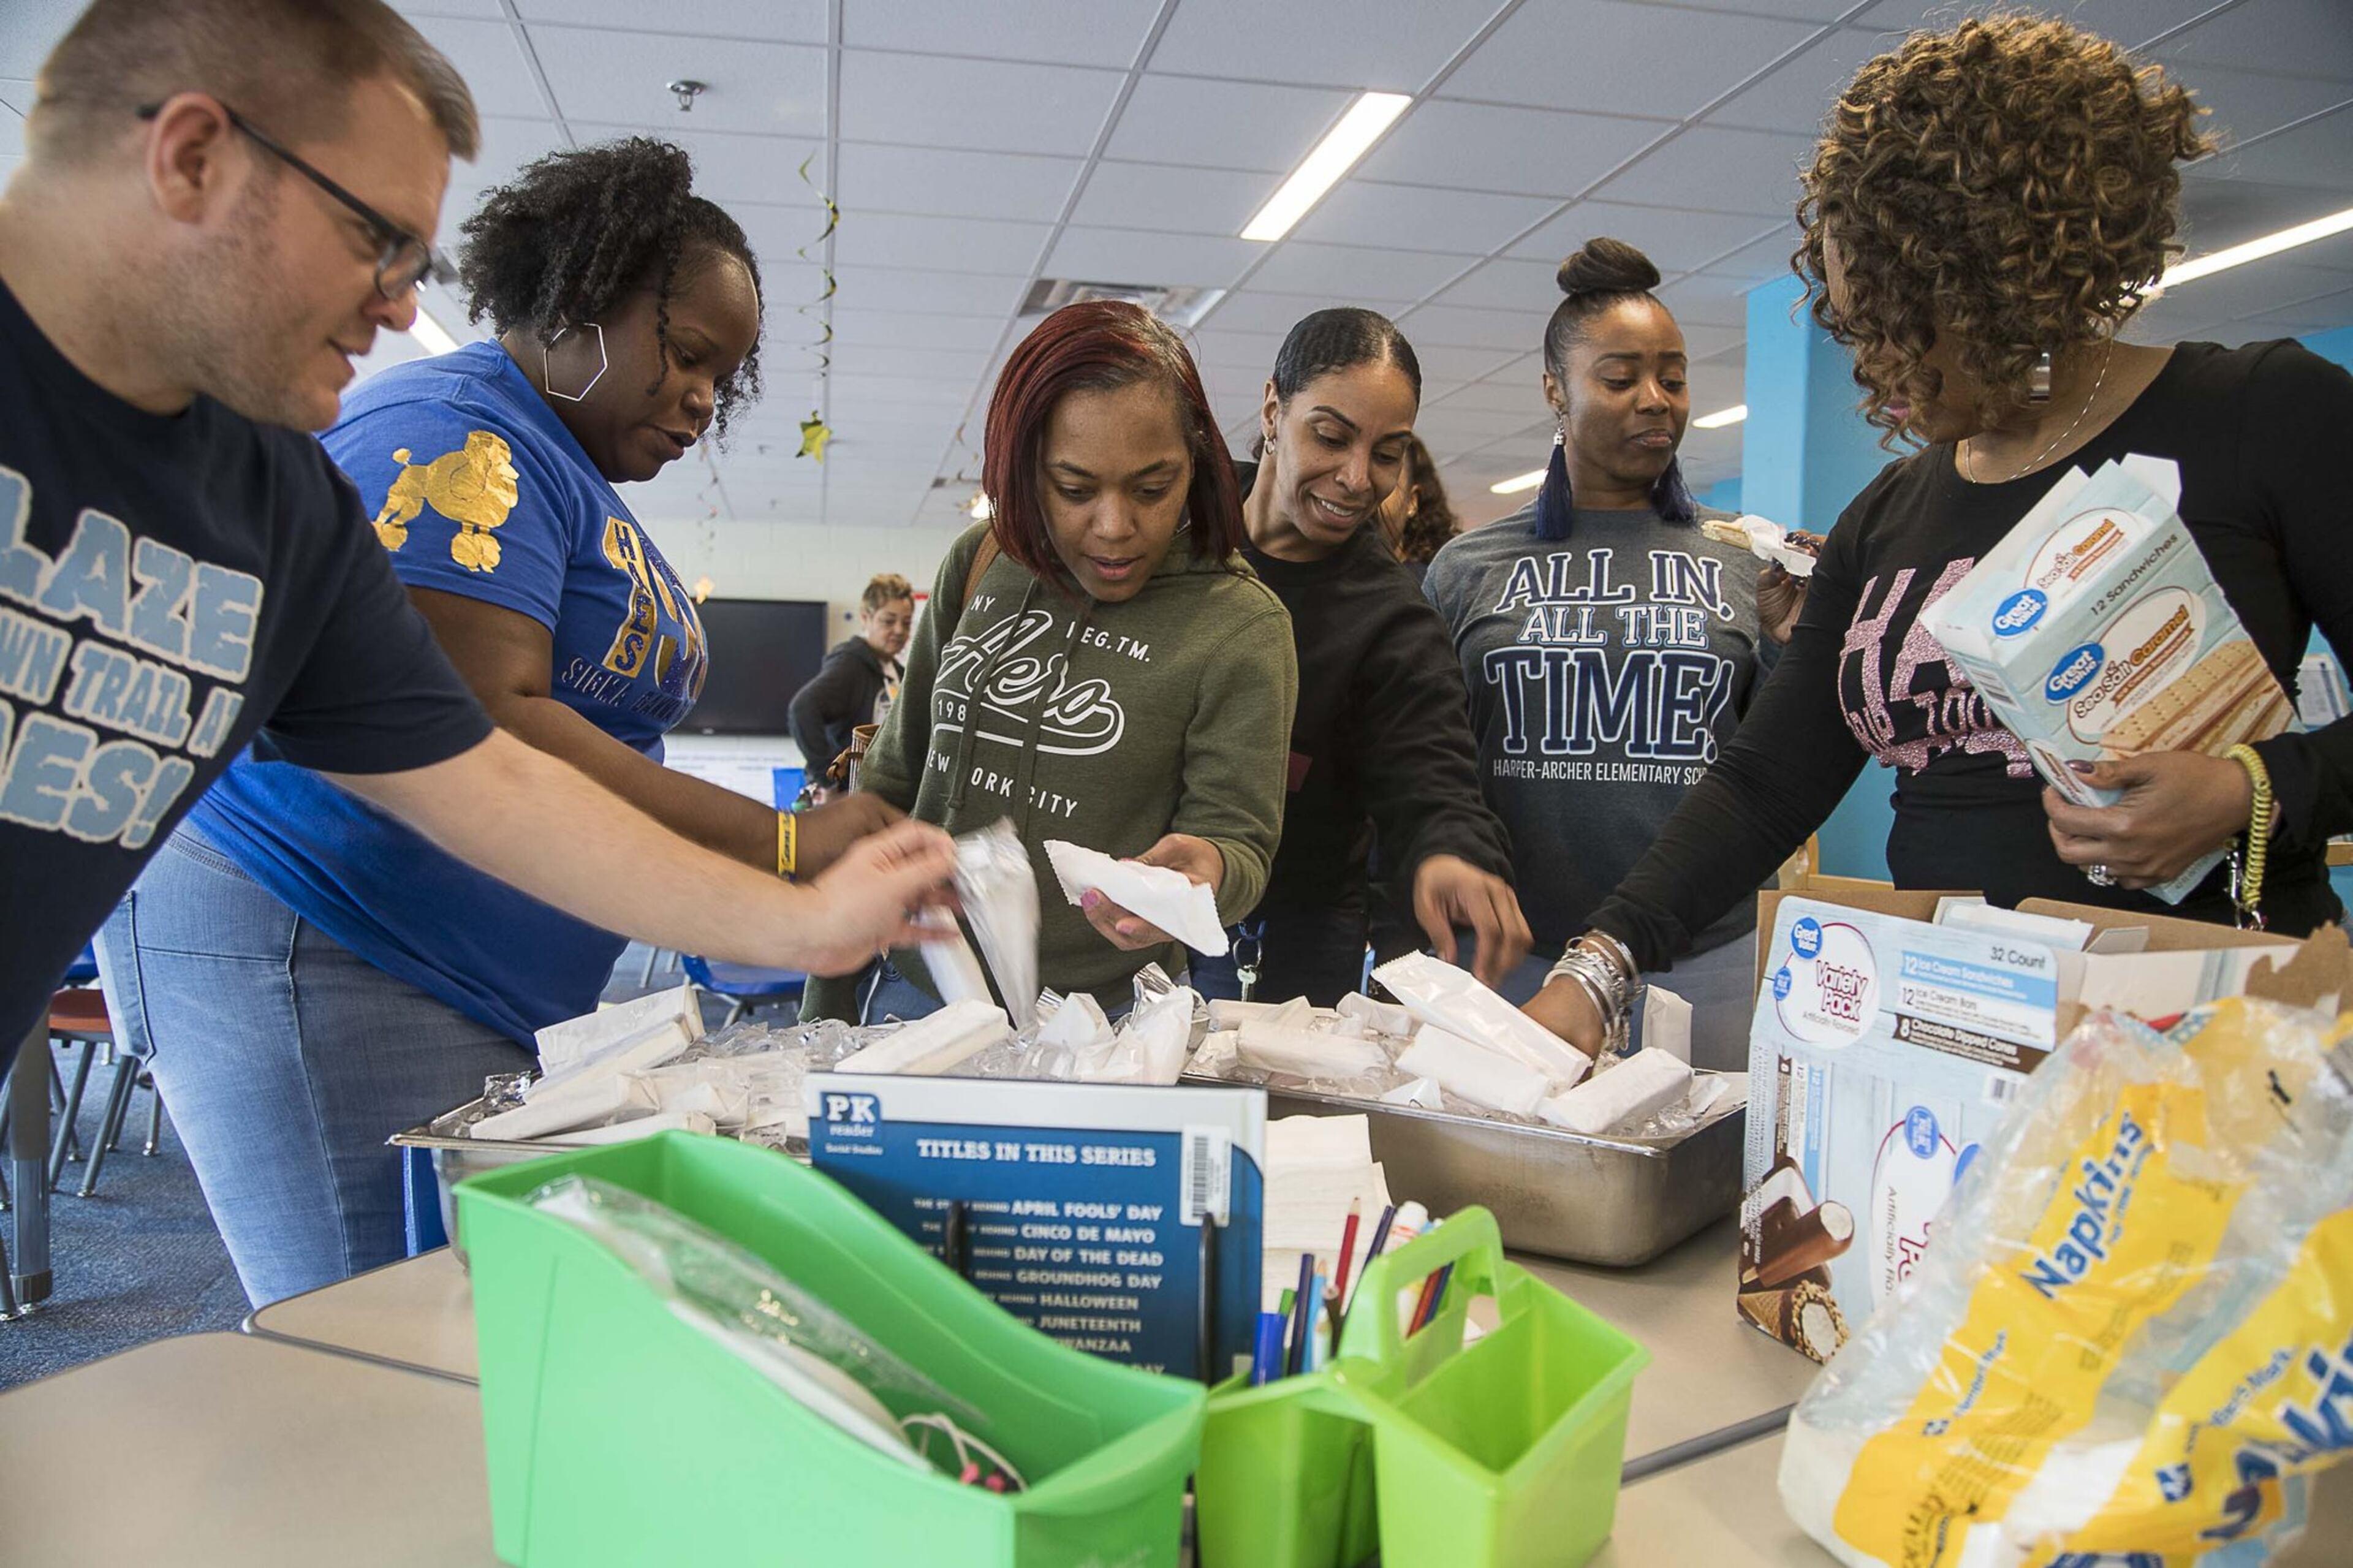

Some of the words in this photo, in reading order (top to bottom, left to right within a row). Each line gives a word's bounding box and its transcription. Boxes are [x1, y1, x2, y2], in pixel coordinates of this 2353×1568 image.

[2072, 518, 2116, 556] Caramel
[1493, 548, 1636, 613] ALL
[2090, 599, 2107, 616] 12
[2106, 534, 2178, 602] Sandwiches
[970, 594, 996, 613] NY
[1994, 594, 2036, 630] Great
[1517, 605, 1608, 646] ALL
[1615, 604, 1710, 648] THE
[2049, 650, 2093, 692] Great
[2064, 659, 2097, 691] Value
[2074, 686, 2106, 719] Sea
[2129, 604, 2190, 667] Caramel
[63, 638, 192, 749] TRAIL
[1483, 645, 1735, 764] TIME!
[937, 699, 968, 722] 198
[0, 697, 195, 850] ES!
[970, 767, 1015, 797] ORK
[1493, 759, 1593, 781] HARPER-ARCHER
[1595, 763, 1681, 785] ELEMENTARY
[1794, 923, 1819, 942] Great
[1904, 955, 1918, 974] 12
[1990, 947, 2005, 962] 32
[2007, 950, 2046, 969] Count
[1816, 960, 1869, 1003] Variety
[1821, 987, 1862, 1022] Pack
[1902, 987, 1915, 1006] 12
[1915, 988, 1928, 998] Ice
[1930, 989, 1958, 1004] Cream
[1900, 1018, 1911, 1037] 8
[1911, 1018, 1955, 1039] Chocolate
[1954, 1029, 1988, 1049] Dipped
[1988, 1039, 2018, 1056] Cones
[826, 1095, 876, 1123] PK
[916, 1138, 991, 1160] TITLES
[995, 1142, 1021, 1161] IN
[1024, 1142, 1077, 1163] THIS
[1080, 1145, 1156, 1167] SERIES
[1011, 1200, 1060, 1217] APRIL
[1126, 1204, 1163, 1221] DAY
[1021, 1223, 1072, 1241] CINCO
[1076, 1225, 1101, 1242] DE
[1104, 1227, 1156, 1244] MAYO
[1014, 1246, 1049, 1261] DAY
[1050, 1248, 1073, 1263] OF
[1078, 1249, 1112, 1264] THE
[1116, 1251, 1164, 1267] DEAD
[1016, 1269, 1122, 1287] GROUNDHOG
[1126, 1273, 1162, 1289] DAY
[1040, 1293, 1139, 1310] HALLOWEEN
[1040, 1316, 1142, 1333] JUNETEENTH
